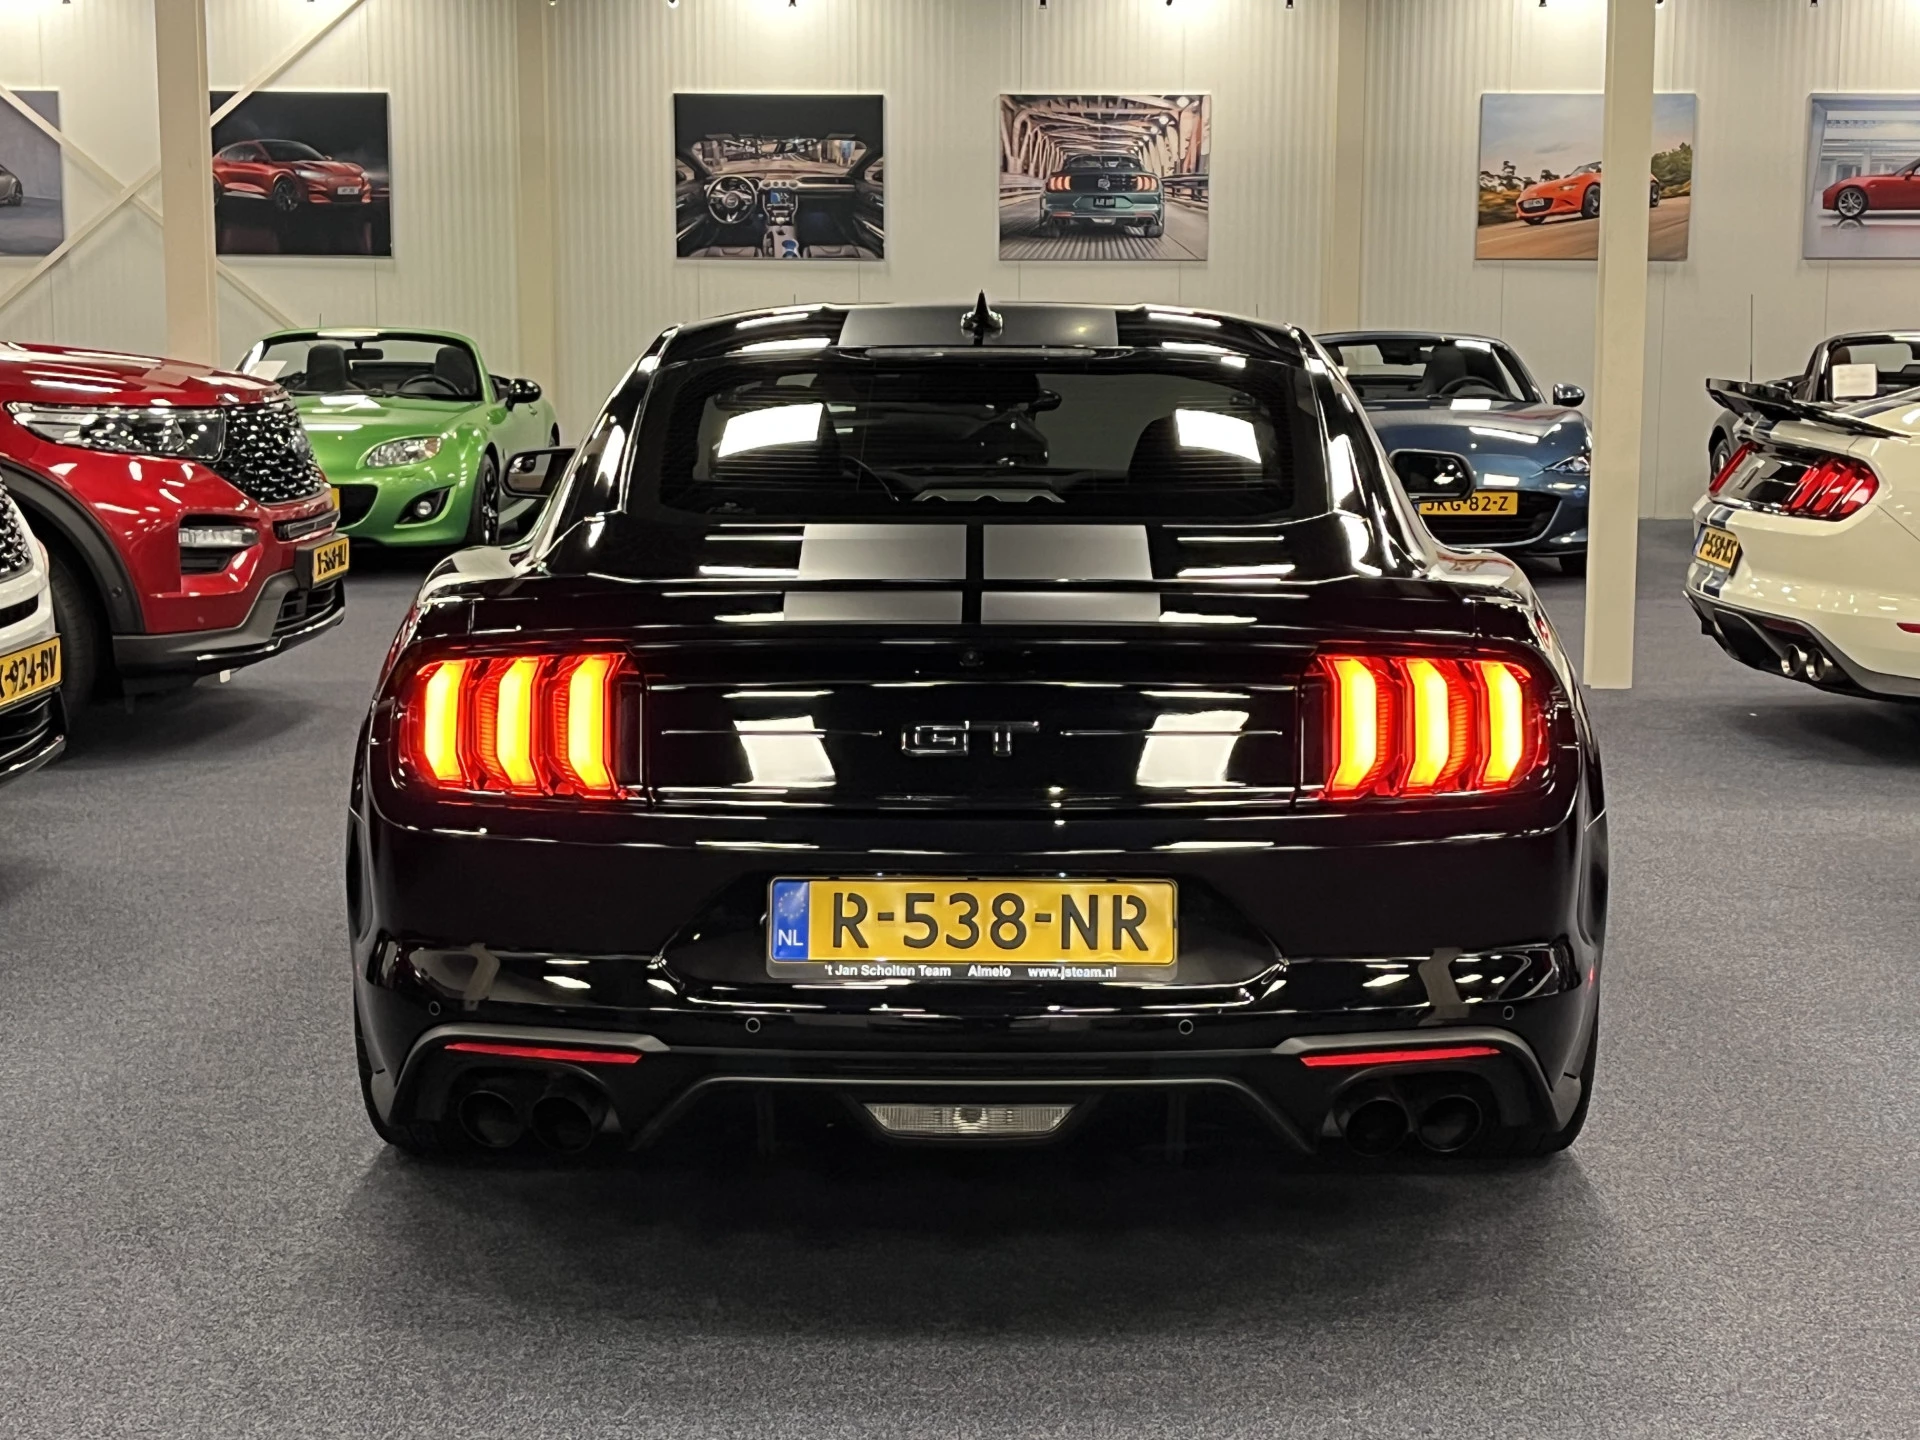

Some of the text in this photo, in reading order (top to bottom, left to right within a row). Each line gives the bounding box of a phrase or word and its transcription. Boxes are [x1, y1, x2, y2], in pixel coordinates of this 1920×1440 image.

[901, 720, 1041, 757] GT
[832, 892, 1149, 952] R-538-NR
[777, 929, 804, 947] NL
[835, 964, 858, 977] Jan
[860, 964, 916, 977] Scholten
[917, 964, 952, 977] Team
[968, 965, 1012, 977] Almelo
[1028, 966, 1117, 980] www.jsteam.nl
